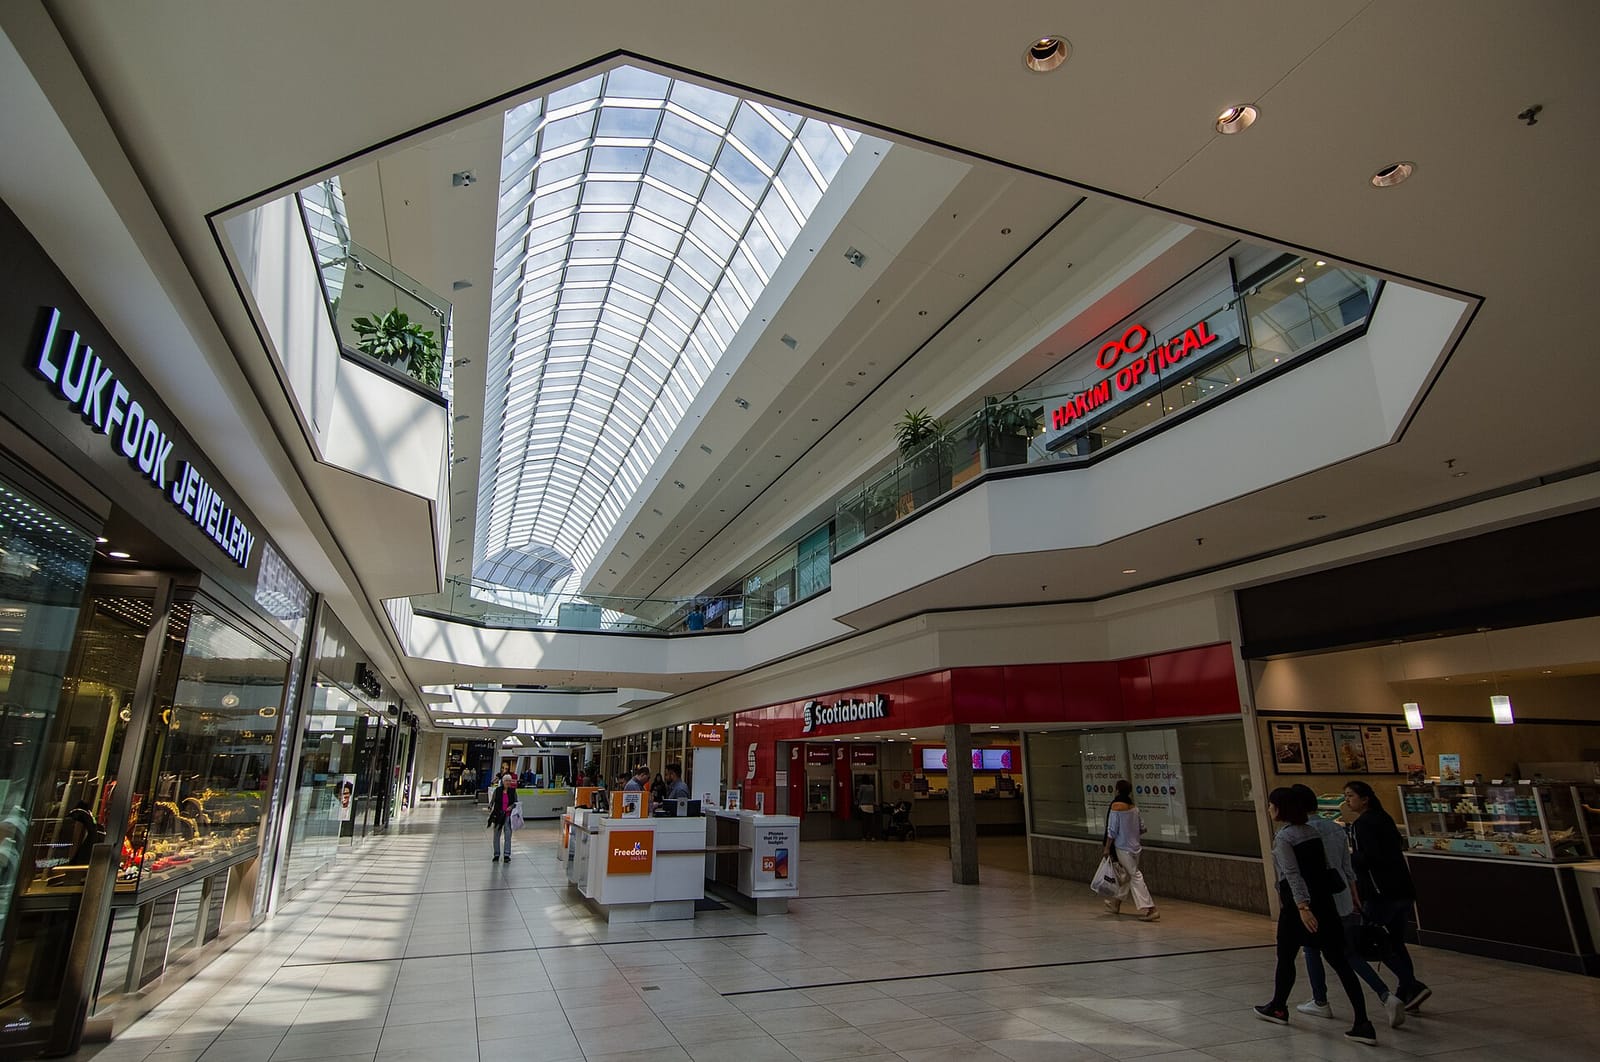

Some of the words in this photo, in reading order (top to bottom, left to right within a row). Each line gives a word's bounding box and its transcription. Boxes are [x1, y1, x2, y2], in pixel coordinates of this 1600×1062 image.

[1053, 379, 1110, 430] HAKIM
[1116, 321, 1216, 391] OPTICAL
[37, 306, 174, 489] LUKFOOK
[171, 460, 255, 568] JEWELLERY
[815, 694, 885, 726] Scotiabank
[698, 731, 721, 739] Freedom
[1132, 753, 1147, 761] More
[1148, 753, 1169, 761] reward
[1133, 763, 1154, 771] options
[613, 847, 648, 857] Freedom
